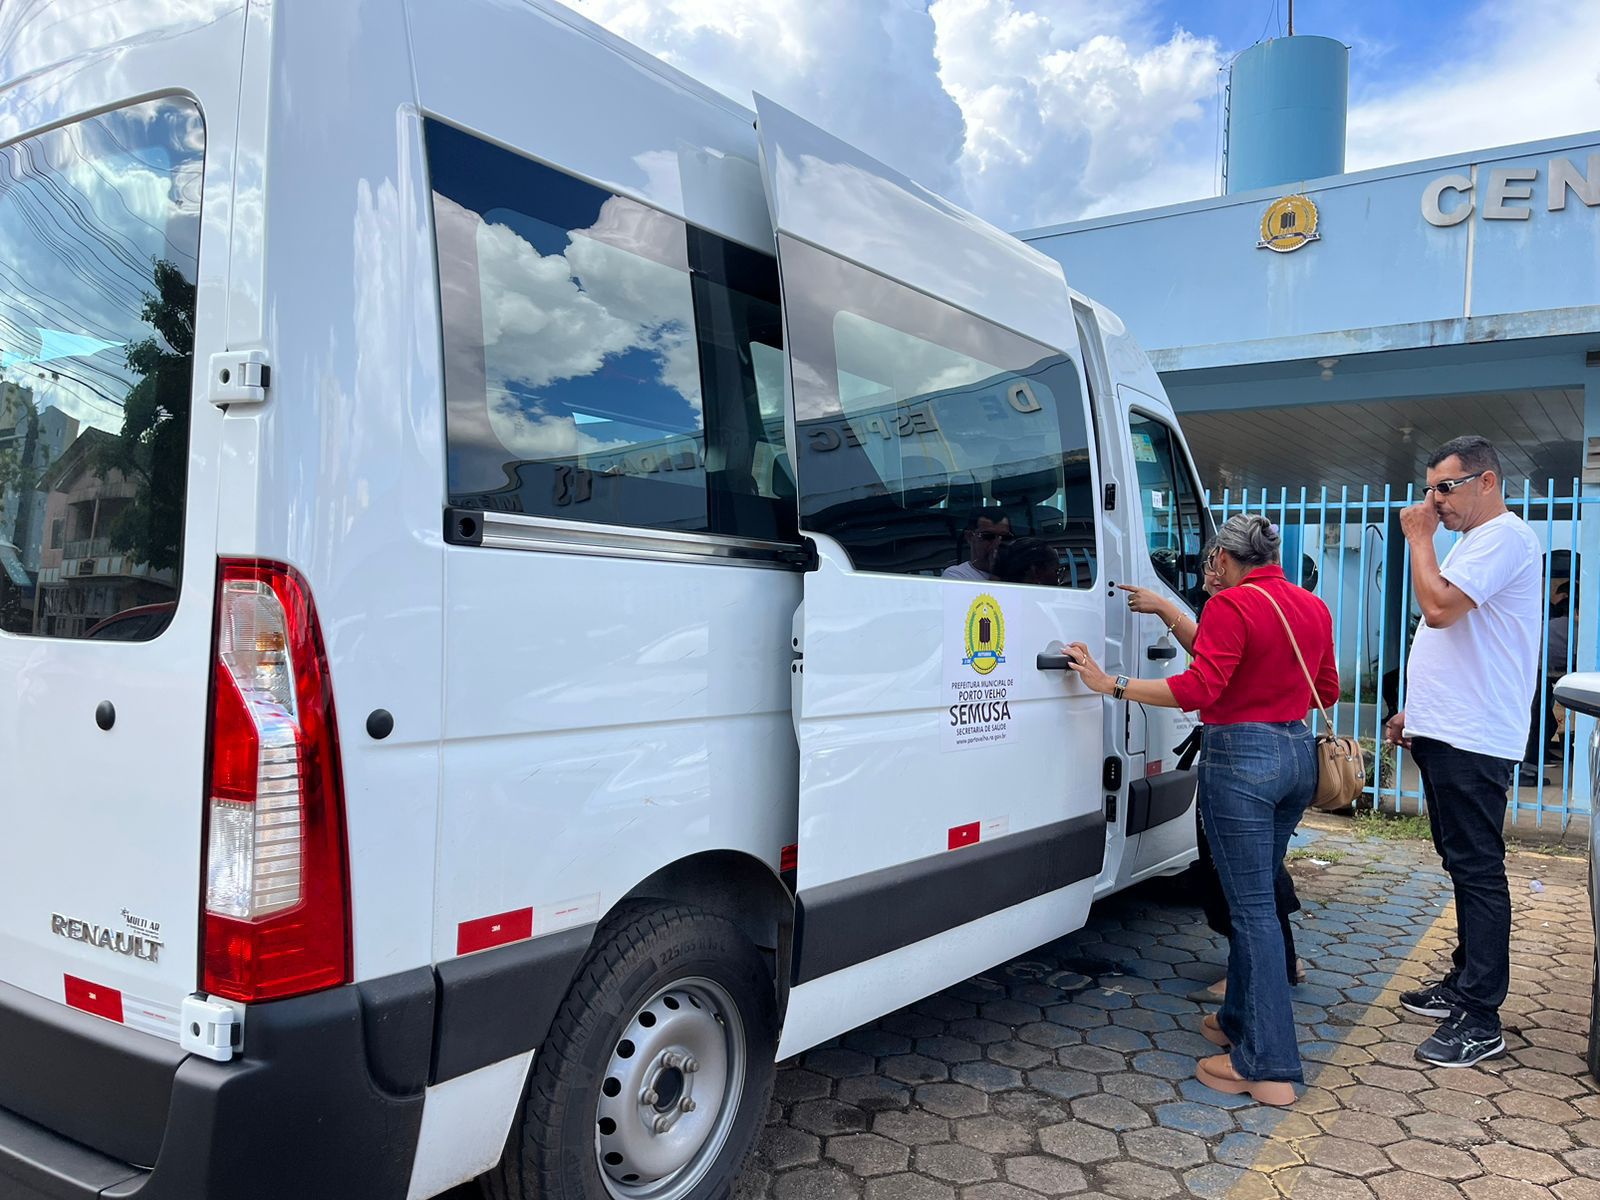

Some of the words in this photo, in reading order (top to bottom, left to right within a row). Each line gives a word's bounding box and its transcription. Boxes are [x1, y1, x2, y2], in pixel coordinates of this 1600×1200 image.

[1421, 154, 1600, 227] CEN
[951, 681, 980, 690] PREFEITURA
[980, 679, 1006, 688] MUNICIPAL
[1007, 678, 1014, 687] DE
[958, 689, 983, 701] PORTO
[984, 688, 1007, 699] VELHO
[949, 701, 1011, 727] SEMUSA
[956, 725, 984, 736] SECRETARIA
[126, 915, 148, 928] MULTI
[149, 921, 160, 932] AR
[491, 924, 501, 933] 3M
[51, 911, 164, 963] RENAULT
